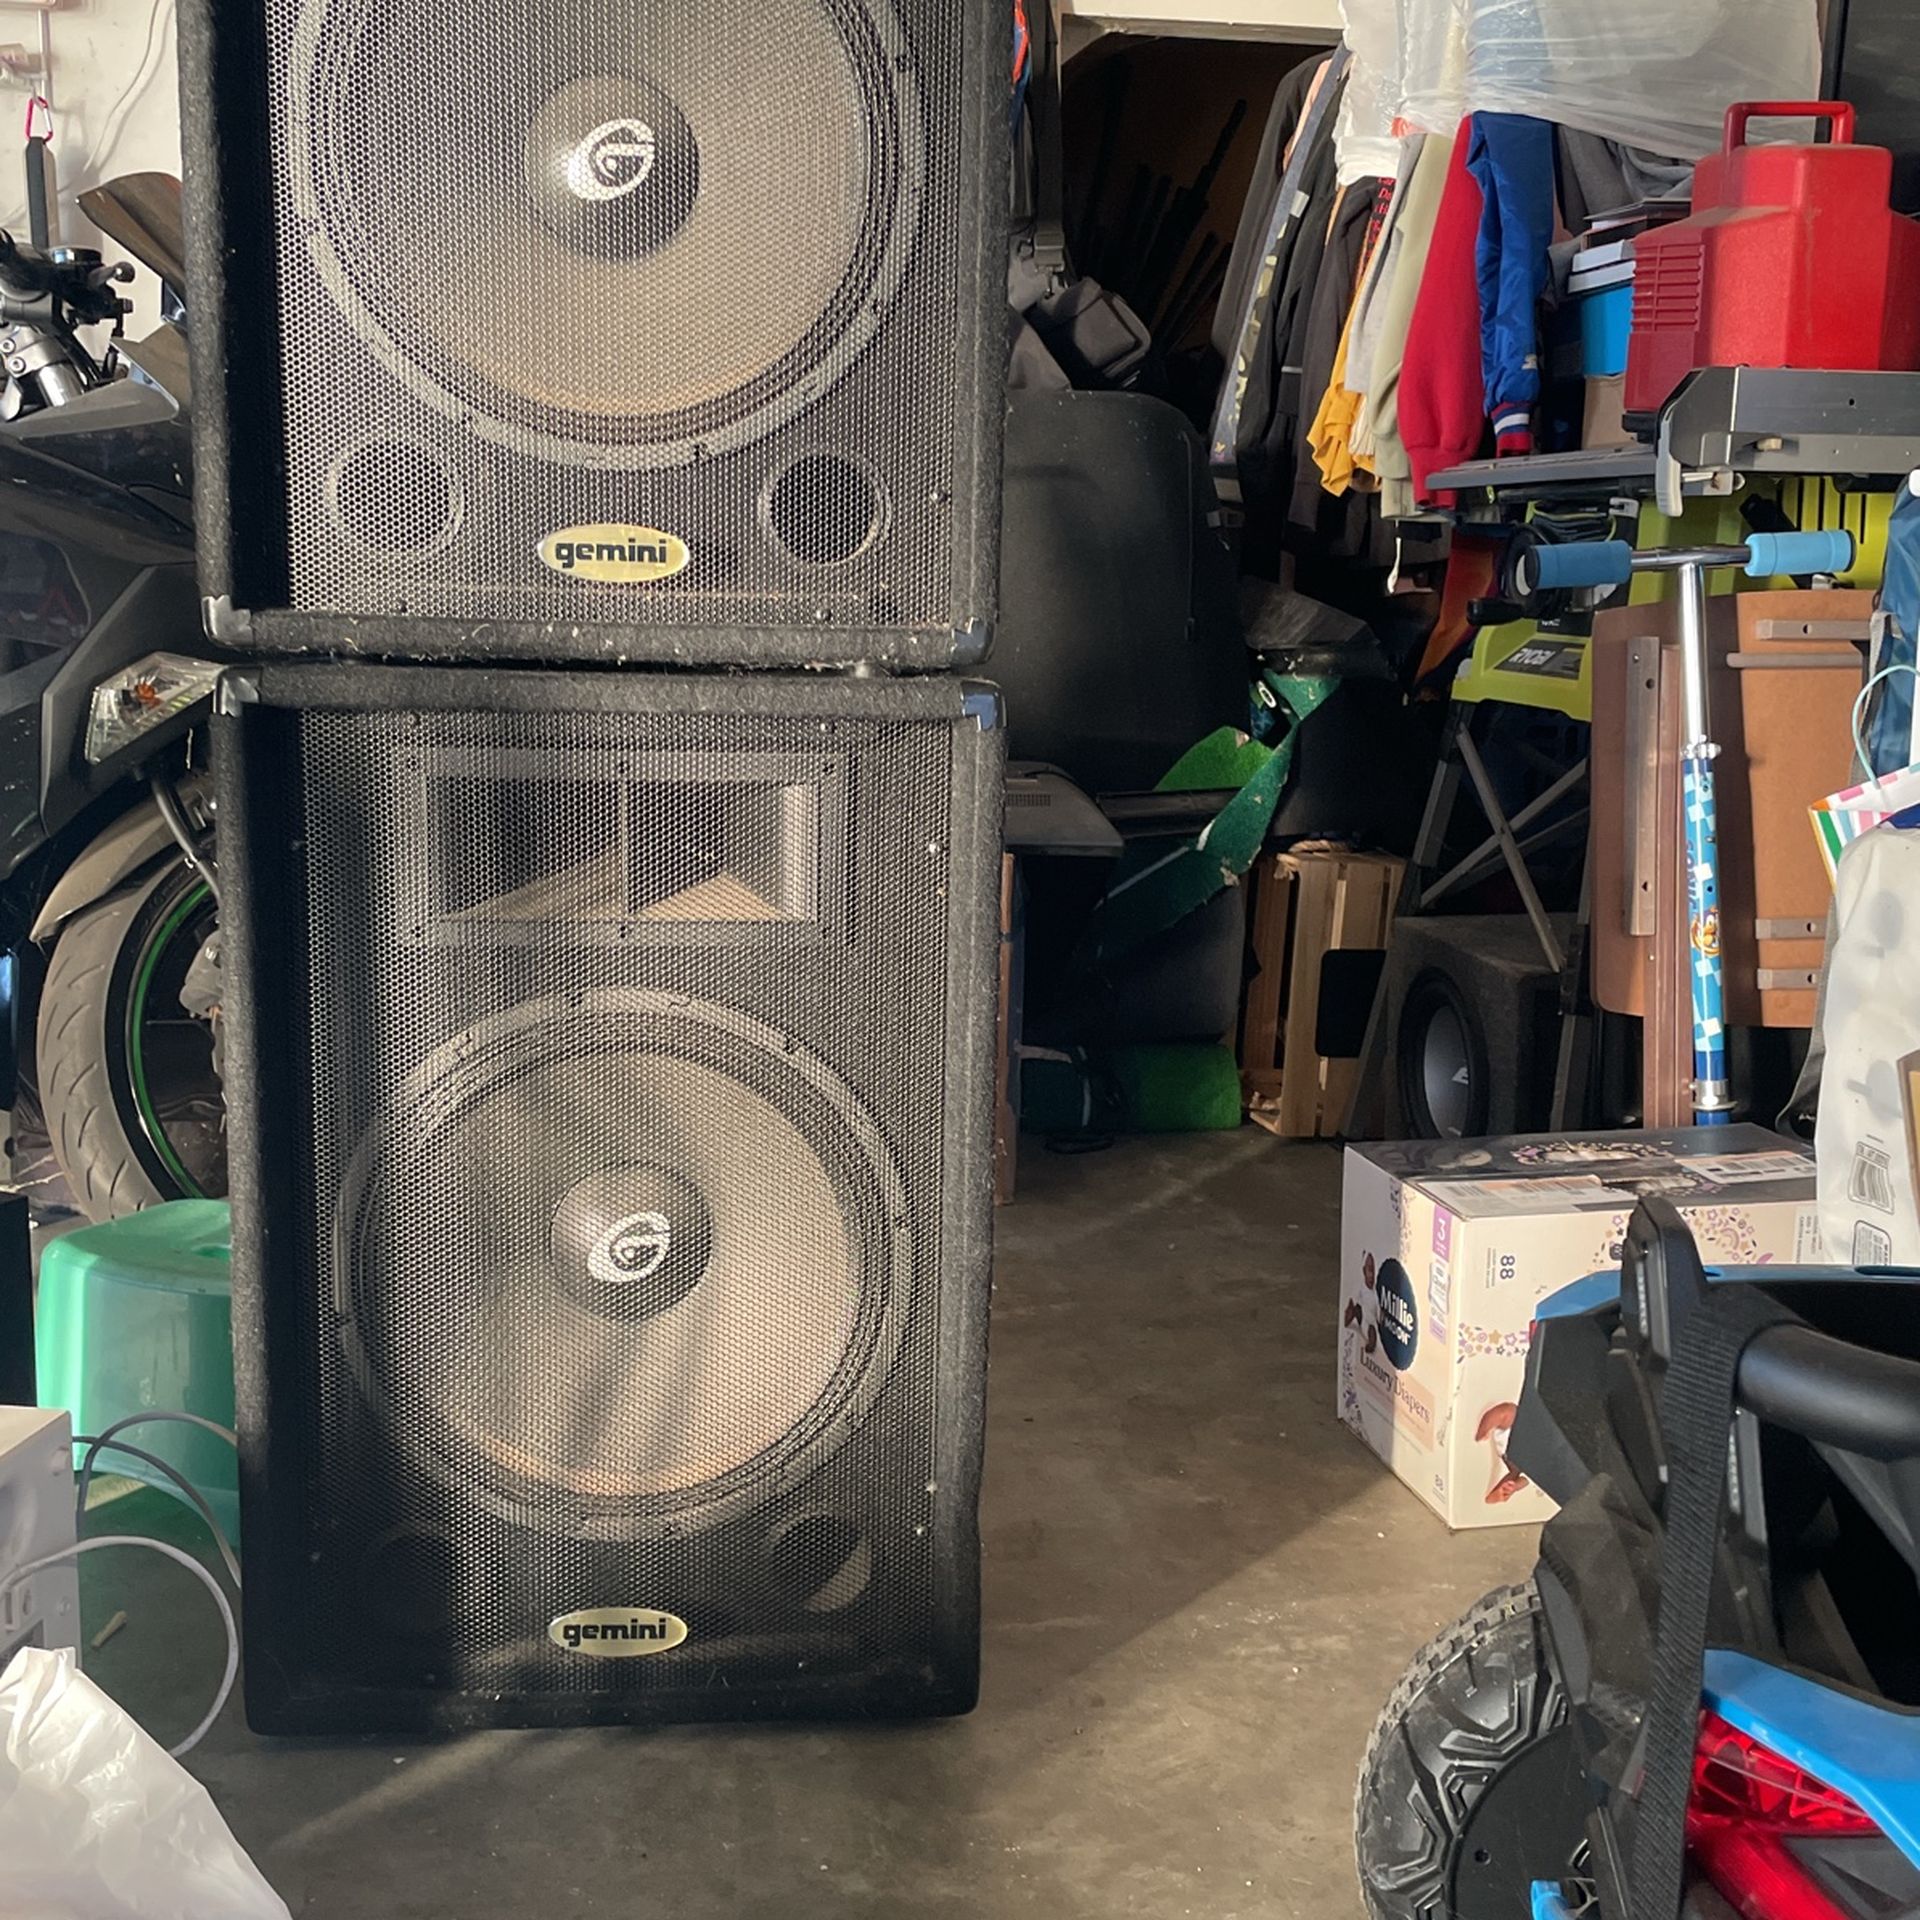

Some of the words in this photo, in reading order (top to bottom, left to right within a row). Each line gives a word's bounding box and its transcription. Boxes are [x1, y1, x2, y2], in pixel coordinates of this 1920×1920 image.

[555, 537, 667, 569] gemini
[1436, 1217, 1447, 1241] 3
[1500, 1254, 1516, 1280] 88
[1380, 1285, 1414, 1332] Millie
[1360, 1346, 1394, 1393] Luxury
[1394, 1375, 1431, 1424] Diapers
[562, 1616, 667, 1648] gemini
